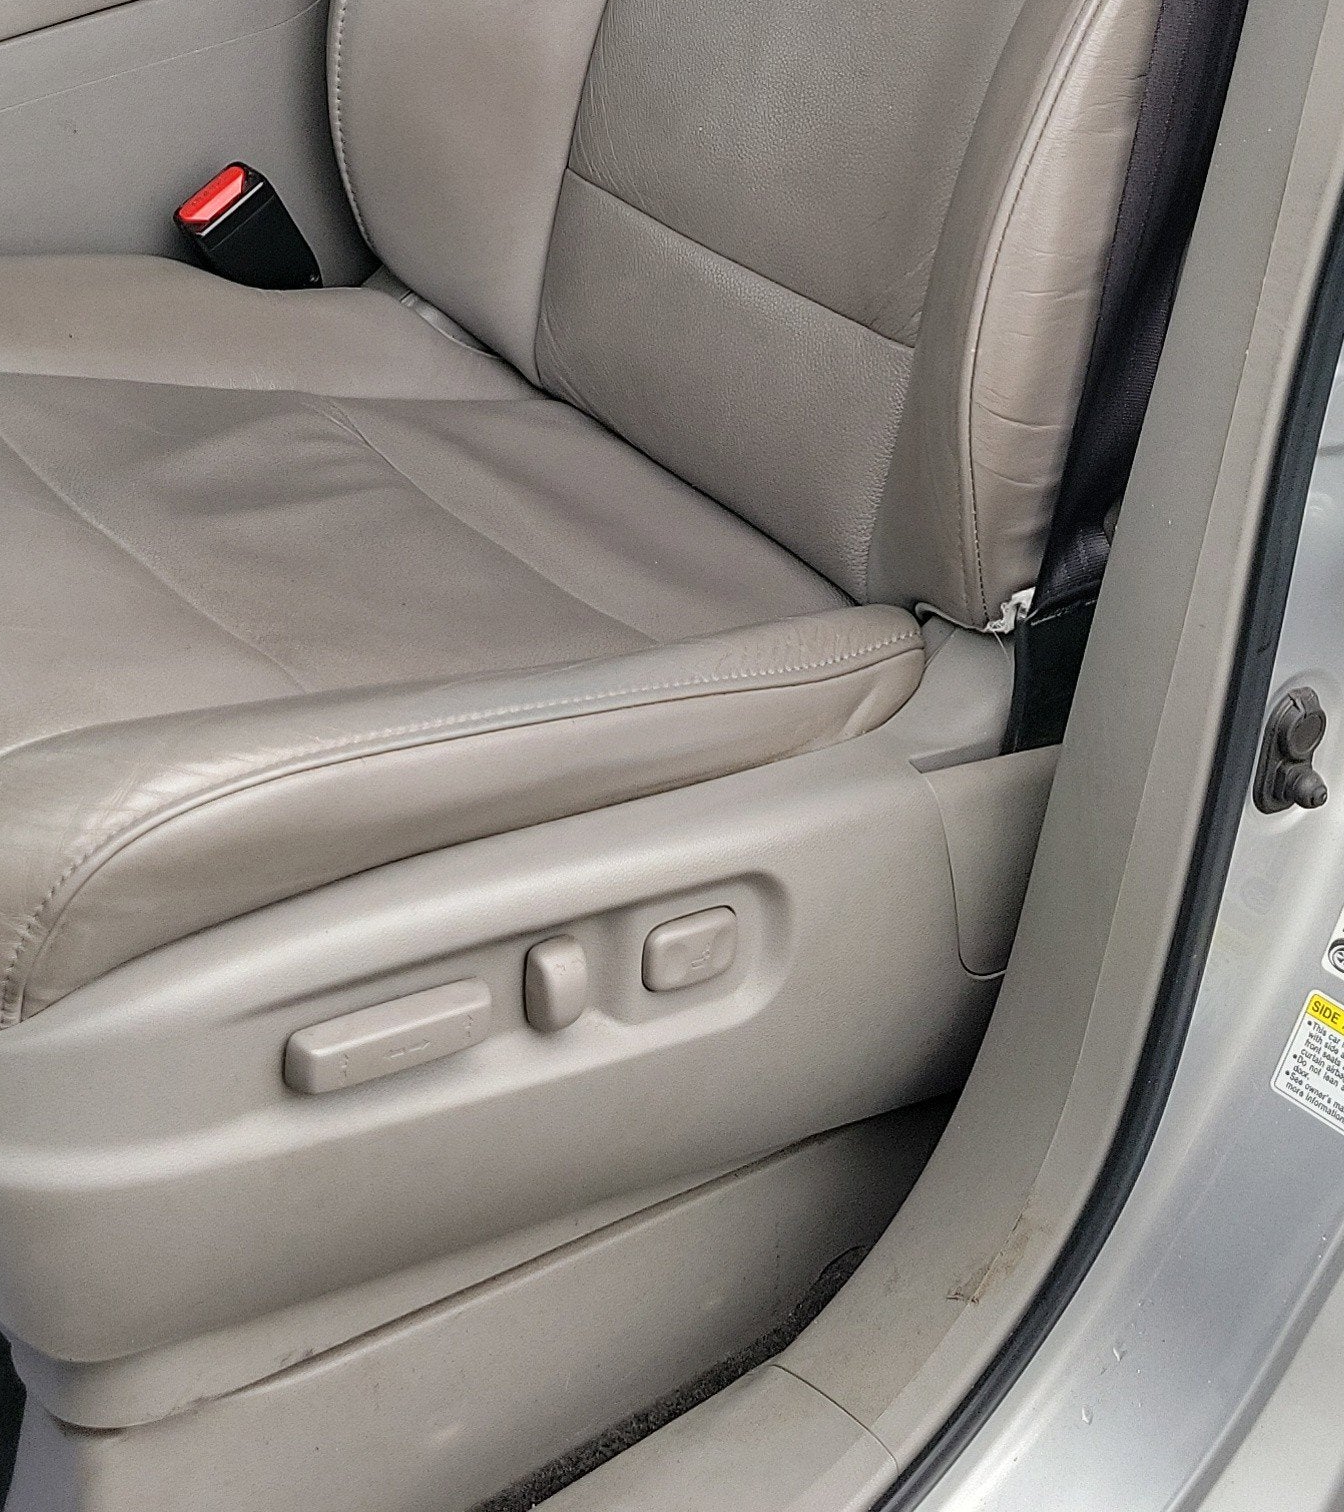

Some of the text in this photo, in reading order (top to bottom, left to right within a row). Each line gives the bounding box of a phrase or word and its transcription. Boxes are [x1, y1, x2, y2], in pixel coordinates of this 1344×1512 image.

[1310, 999, 1341, 1025] SIDE
[1307, 1030, 1324, 1045] with
[1323, 1040, 1340, 1055] side
[1311, 1021, 1328, 1037] This
[1327, 1032, 1341, 1045] car
[1299, 1047, 1325, 1067] curtain
[1303, 1038, 1322, 1054] front
[1321, 1050, 1342, 1067] seats
[1296, 1055, 1307, 1067] Do
[1308, 1063, 1321, 1076] not
[1322, 1072, 1339, 1087] lean
[1284, 1081, 1304, 1097] more
[1288, 1071, 1304, 1086] See
[1303, 1081, 1332, 1104] owner's
